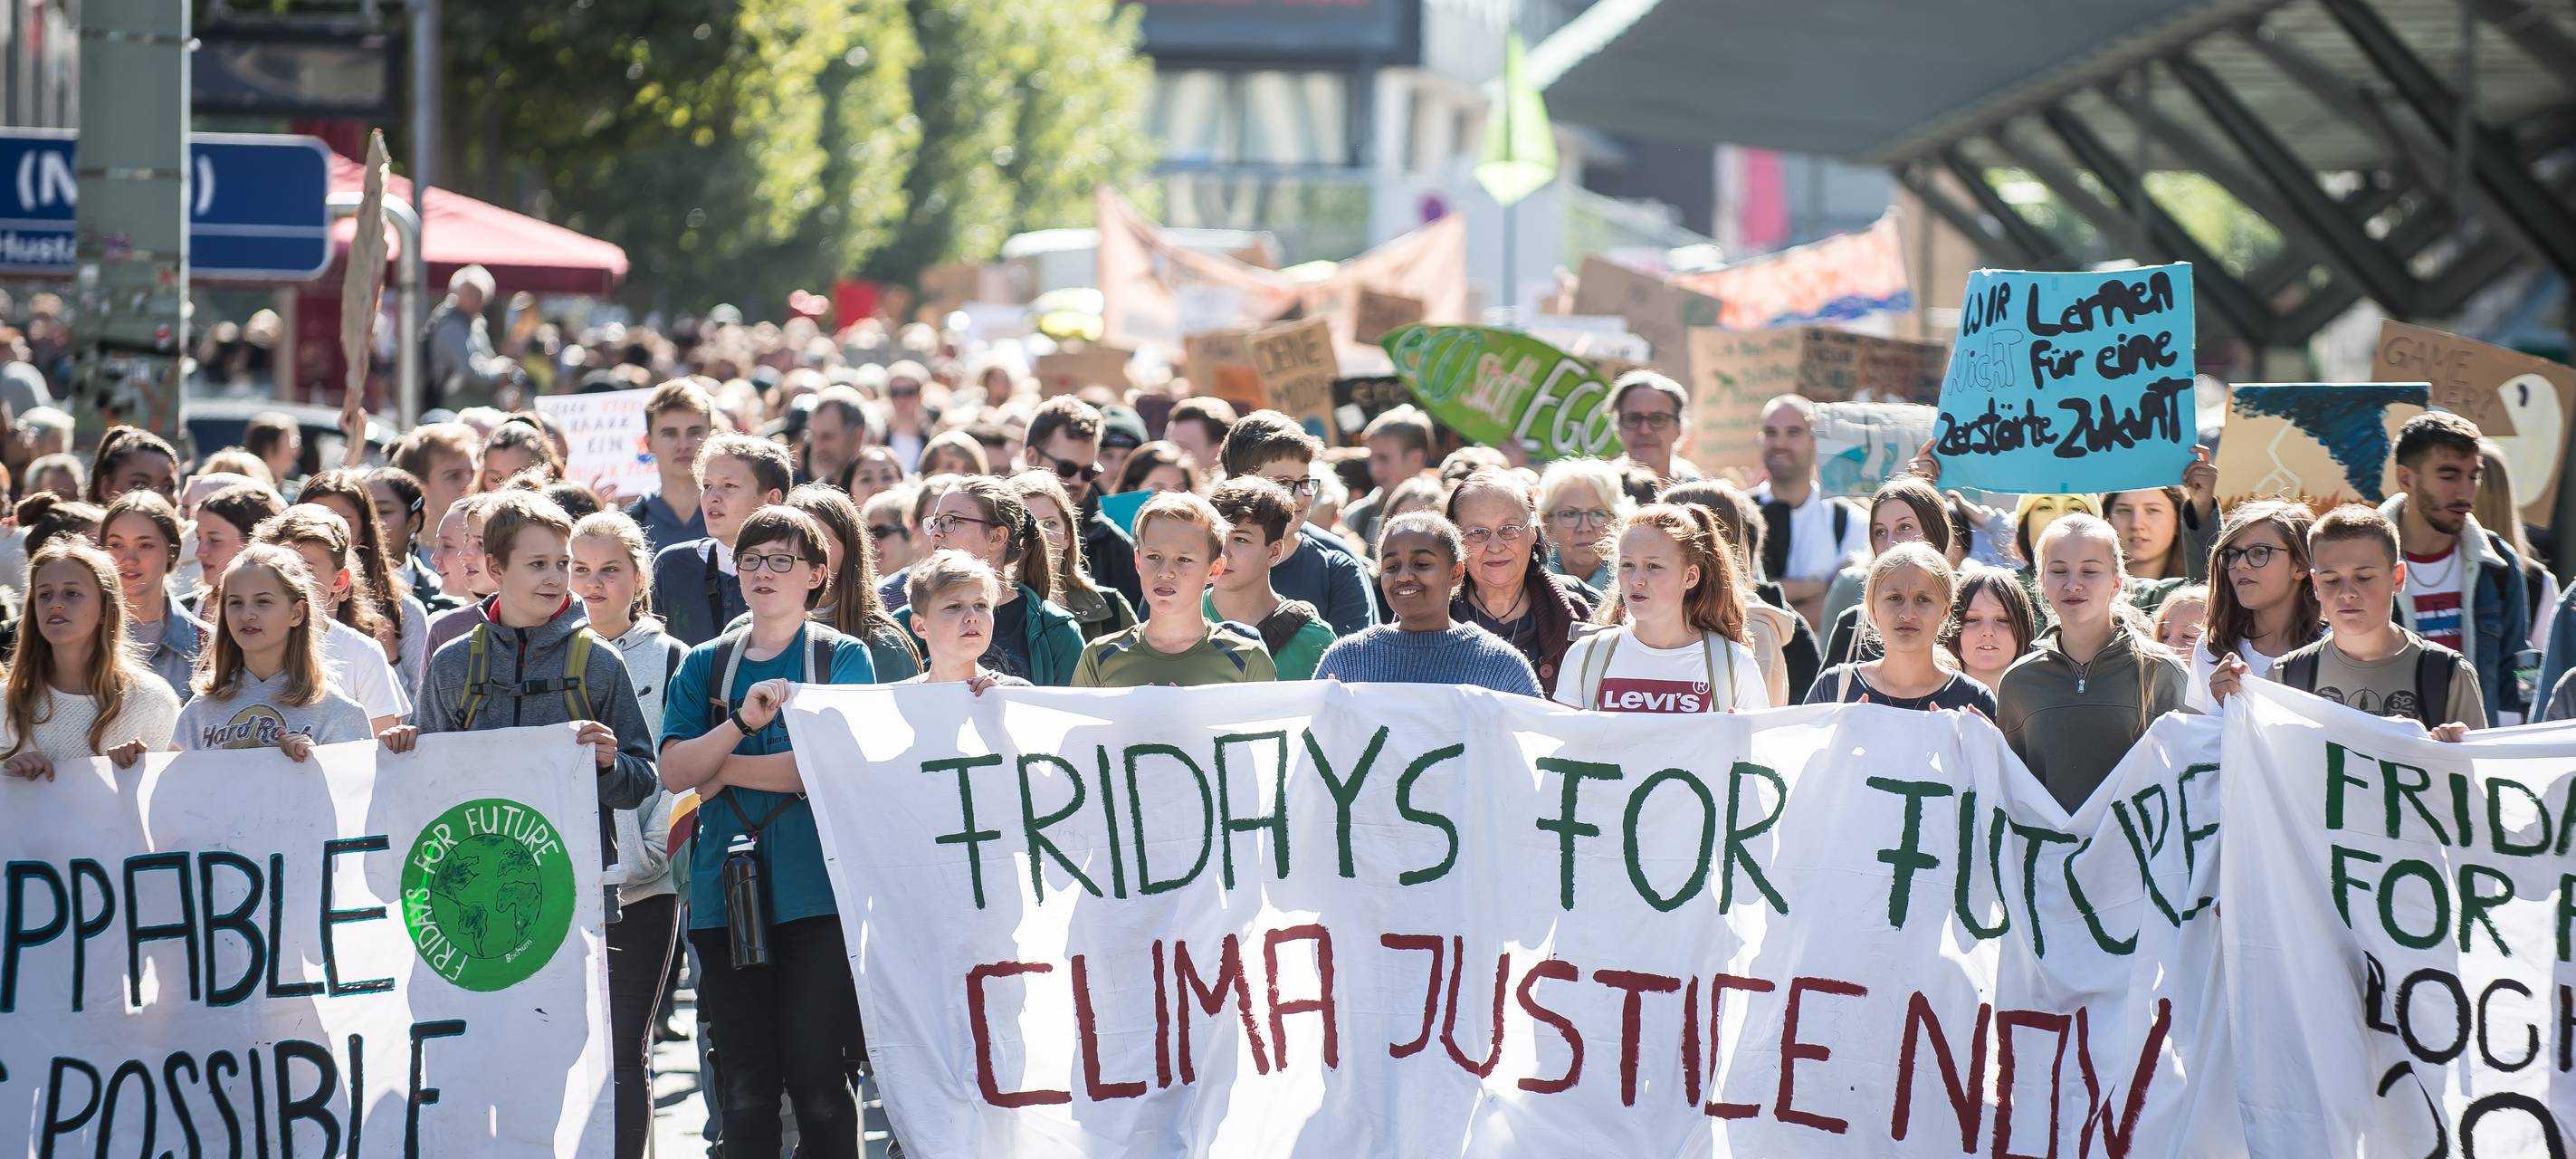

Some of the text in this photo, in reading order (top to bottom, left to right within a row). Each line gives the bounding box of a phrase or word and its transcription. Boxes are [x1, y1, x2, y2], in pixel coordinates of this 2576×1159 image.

[1963, 271, 2172, 337] WIR Lernen
[2096, 330, 2177, 379] eine
[1513, 358, 1615, 453] EGO
[2430, 380, 2495, 420] VER?
[203, 714, 257, 748] Hard
[2390, 694, 2415, 711] 62
[921, 725, 1465, 909] FRIDAYS
[1537, 761, 1789, 915] FOR
[405, 805, 559, 982] FRIDAYS FOR FUTURE
[2331, 843, 2512, 958] FOR
[505, 939, 533, 963] Bochum
[966, 924, 1338, 1108] CLIMA
[1380, 933, 1867, 1134] JUSTICE
[1891, 990, 2172, 1159] NOW
